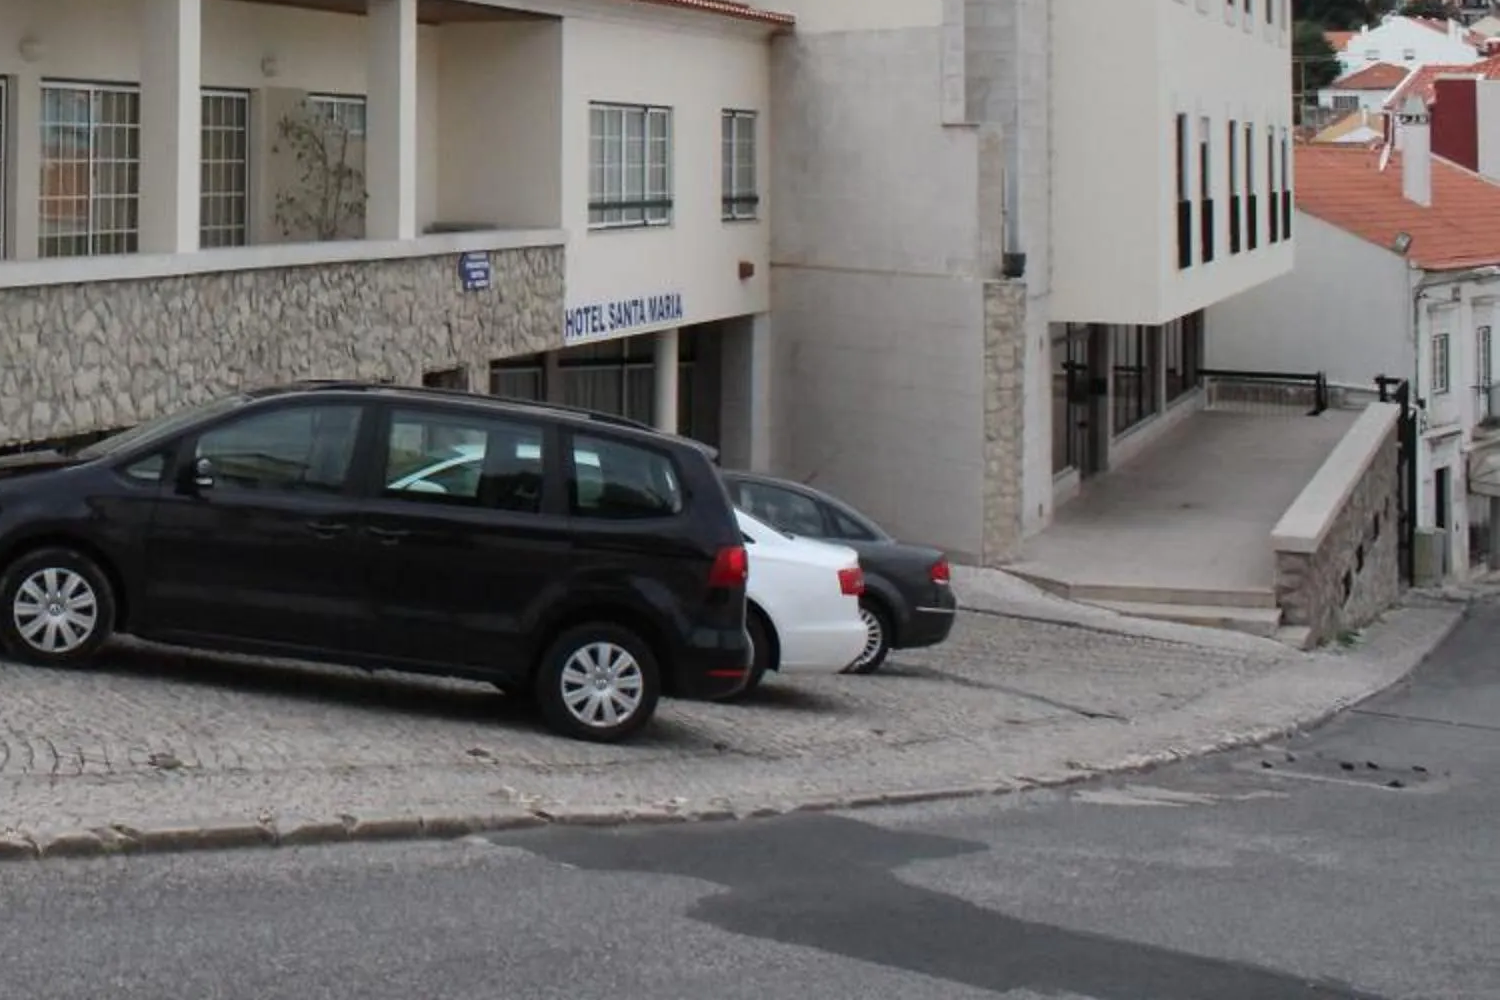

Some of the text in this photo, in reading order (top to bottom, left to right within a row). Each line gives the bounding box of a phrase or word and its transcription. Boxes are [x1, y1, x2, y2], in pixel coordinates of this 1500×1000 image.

[565, 294, 683, 336] HOTEL SANTA MARIA
